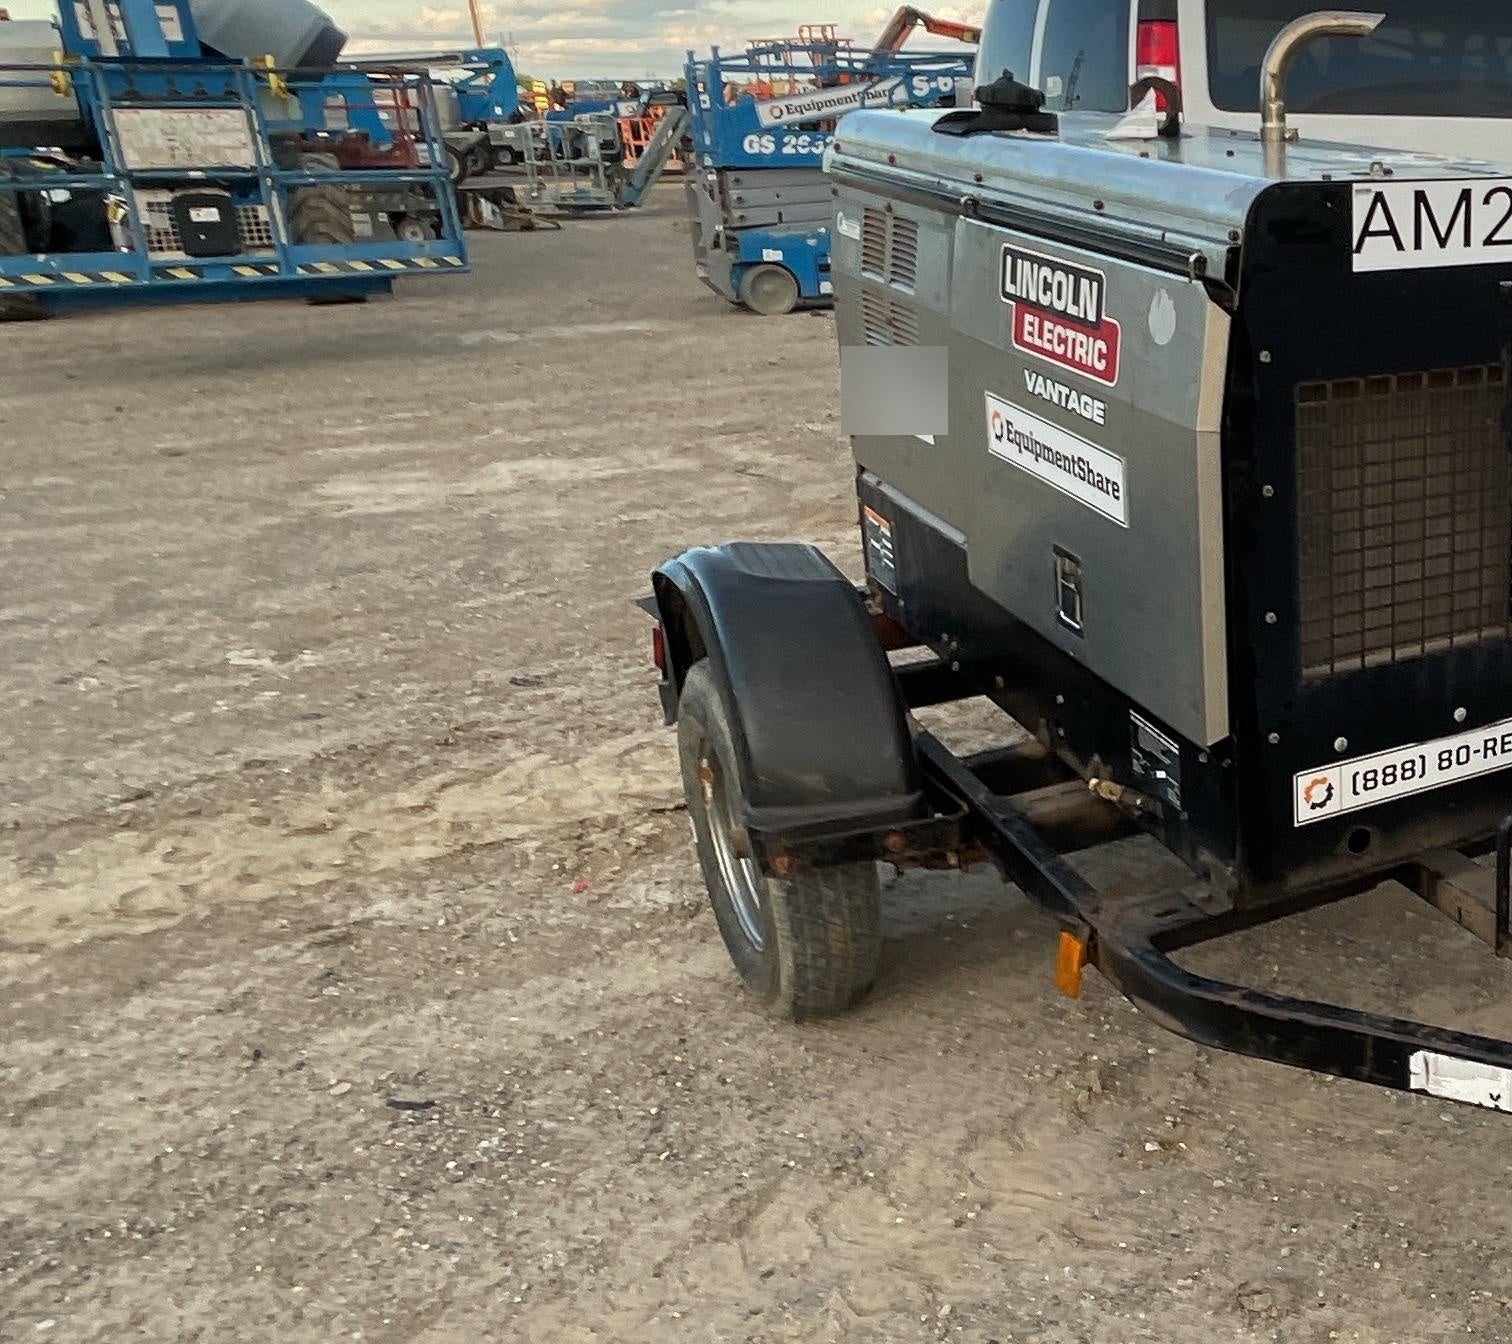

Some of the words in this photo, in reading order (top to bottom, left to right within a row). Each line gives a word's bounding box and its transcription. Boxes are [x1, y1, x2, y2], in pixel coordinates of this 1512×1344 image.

[742, 134, 776, 154] GS
[1004, 254, 1098, 322] LINCOLN
[1023, 313, 1108, 371] ELECTRIC
[1023, 368, 1106, 425] VANTAGE
[1006, 419, 1121, 501] EquipmentShare
[1351, 754, 1427, 796] (888)
